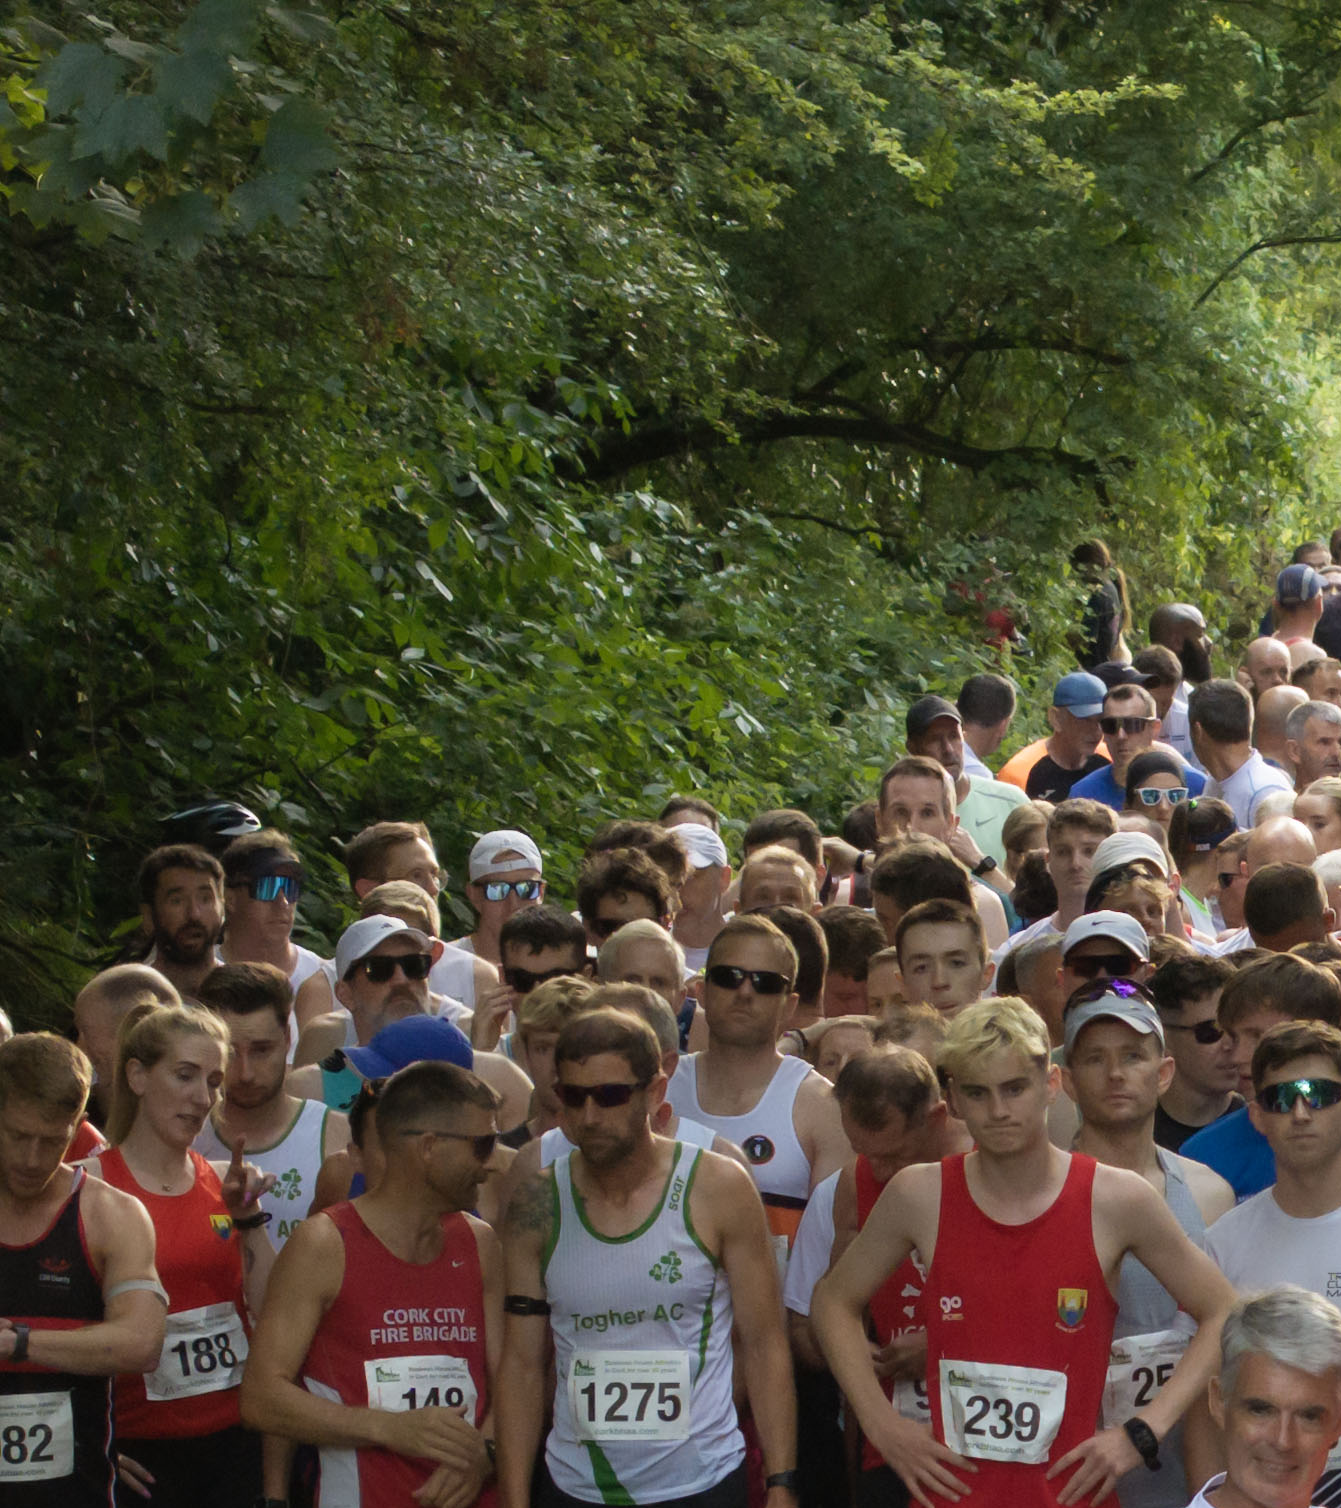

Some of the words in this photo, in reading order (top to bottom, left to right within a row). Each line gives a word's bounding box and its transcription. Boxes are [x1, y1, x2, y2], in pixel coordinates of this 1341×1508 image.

[668, 1176, 685, 1211] soar
[383, 1308, 430, 1325] CORK
[433, 1307, 465, 1323] CITY
[570, 1309, 645, 1333] Togher
[653, 1303, 684, 1323] AC
[370, 1327, 409, 1345] FIRE
[412, 1326, 477, 1342] BRIGADE
[171, 1333, 238, 1377] 188
[581, 1382, 682, 1422] 1275
[964, 1395, 1040, 1443] 239
[0, 1424, 54, 1464] 82
